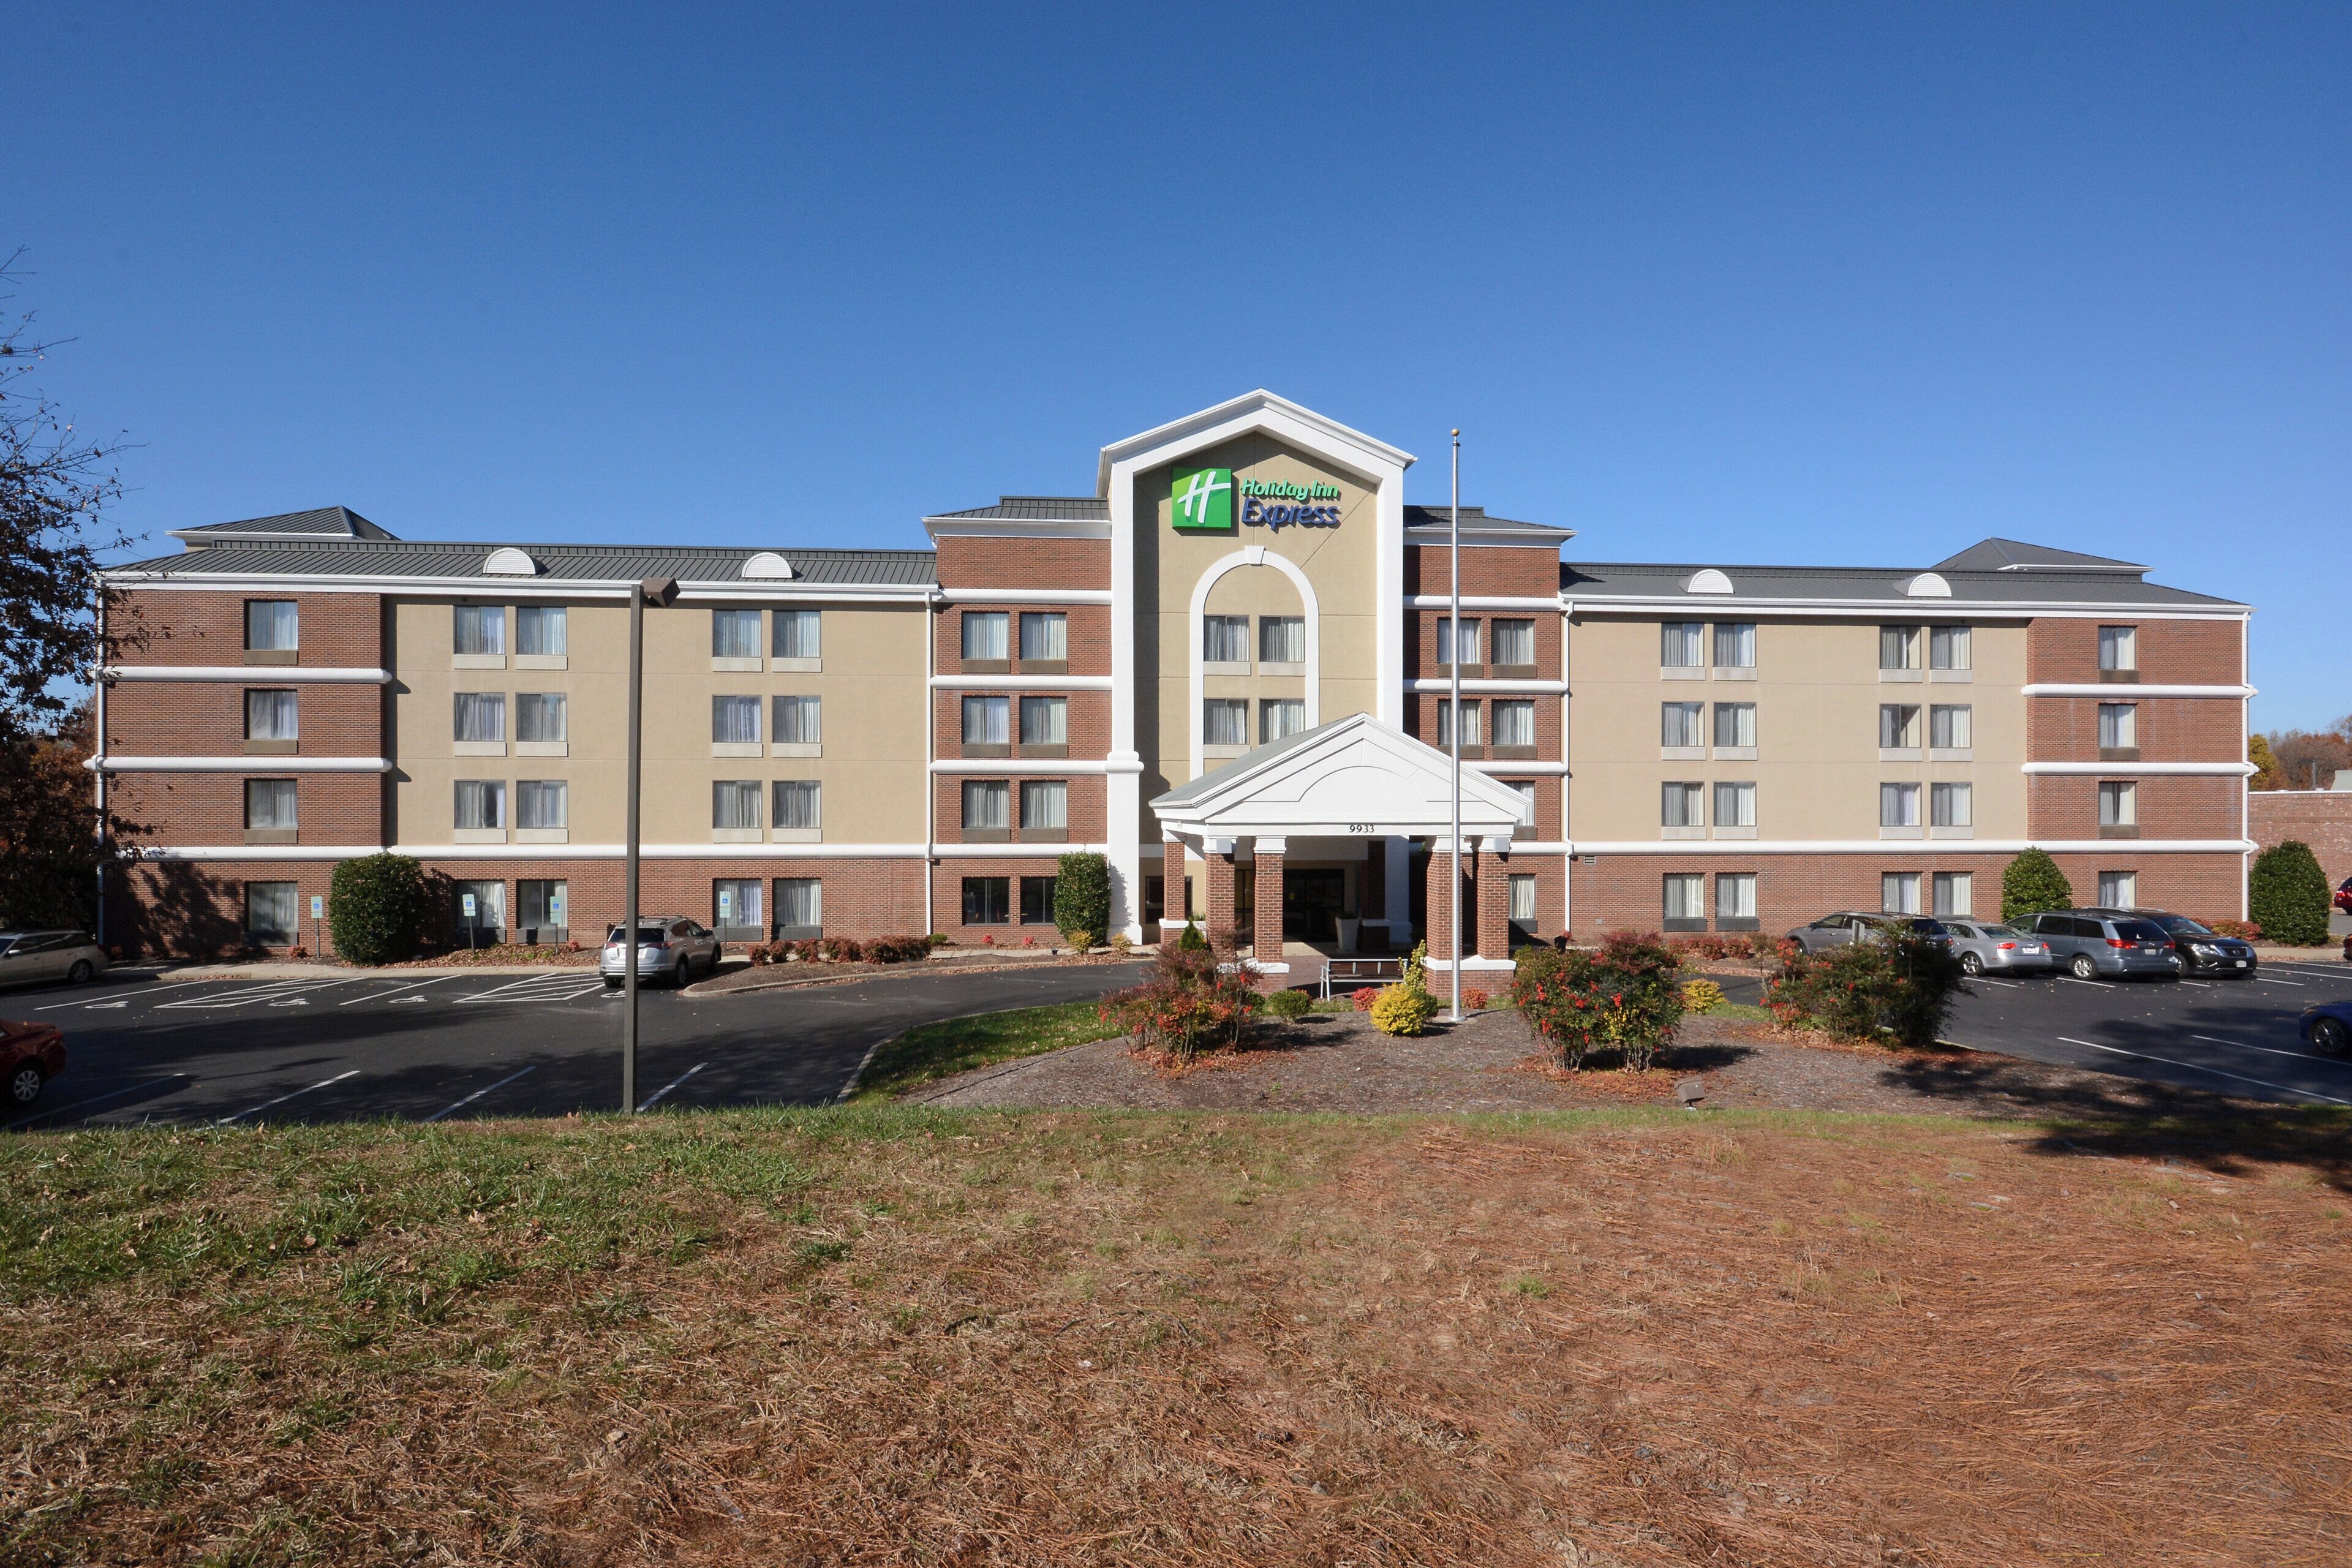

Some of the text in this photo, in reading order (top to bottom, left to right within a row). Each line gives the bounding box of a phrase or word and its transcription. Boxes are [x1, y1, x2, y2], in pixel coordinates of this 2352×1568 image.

[1241, 477, 1338, 500] Holiday Inn
[1242, 497, 1338, 529] Express
[1349, 824, 1374, 833] 9933
